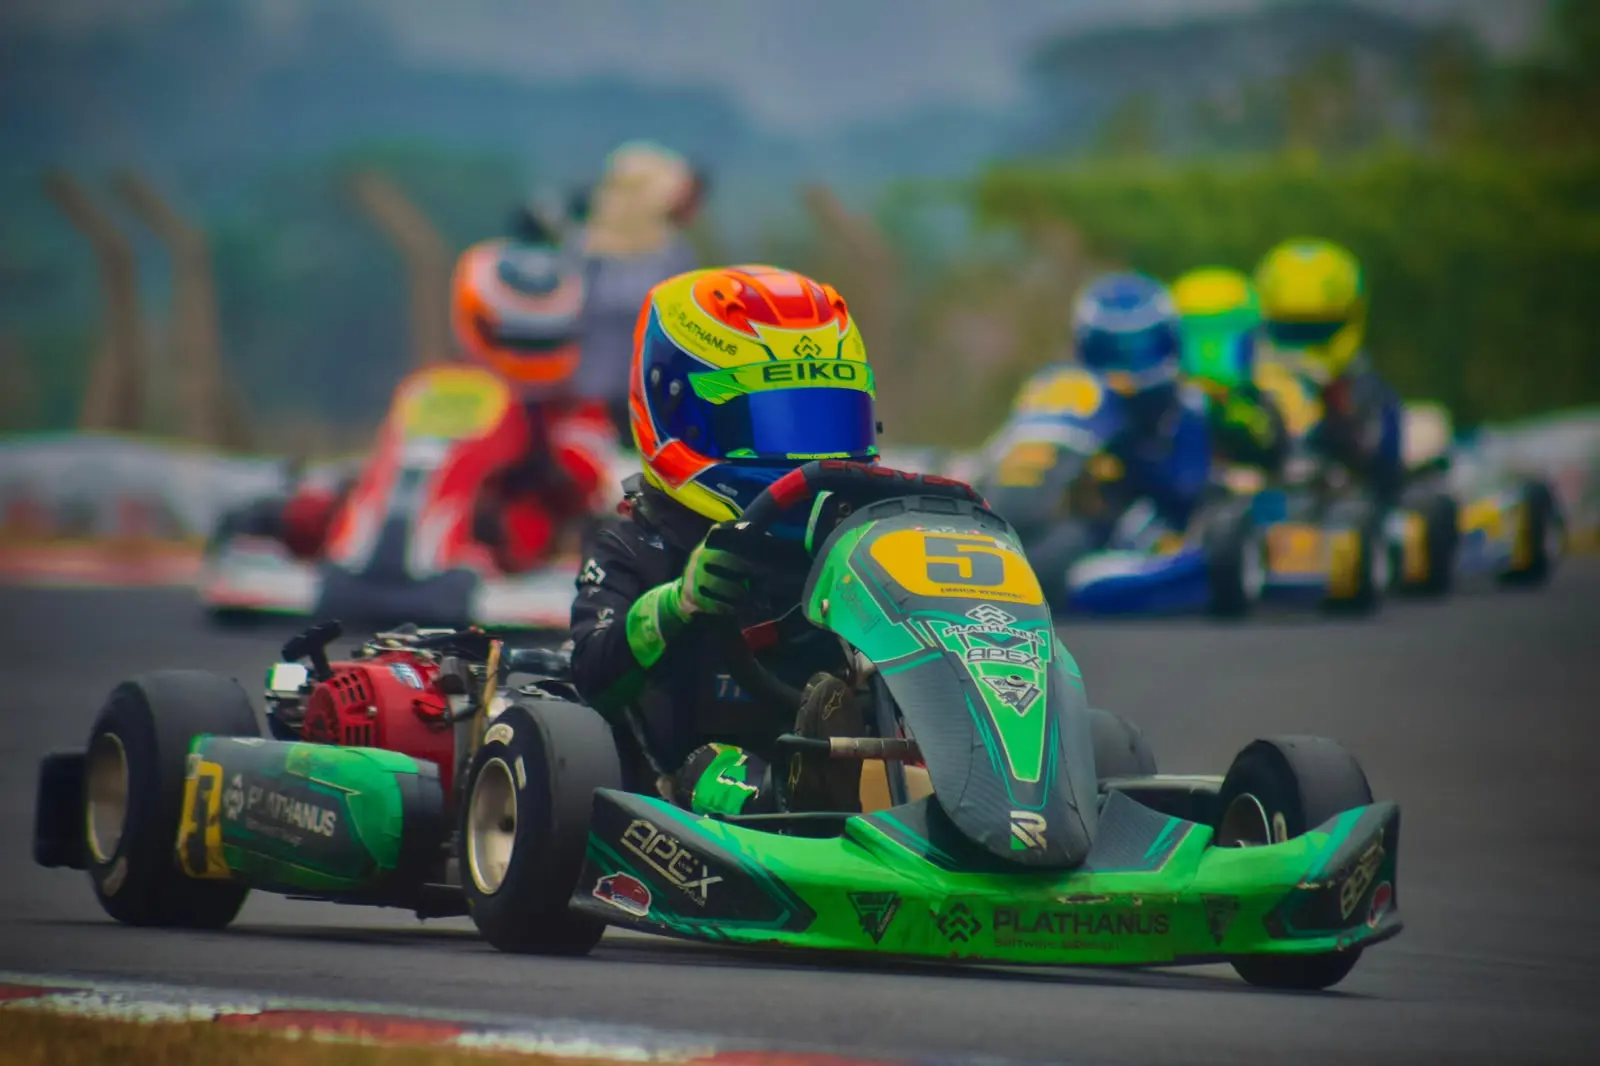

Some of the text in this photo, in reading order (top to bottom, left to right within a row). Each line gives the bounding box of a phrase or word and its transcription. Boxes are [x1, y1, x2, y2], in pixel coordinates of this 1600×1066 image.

[678, 311, 738, 356] PLATHANUS
[763, 363, 856, 383] EIKO
[924, 536, 1004, 587] 5
[943, 624, 1046, 646] PLATHANUS
[968, 648, 1042, 671] APEX
[621, 819, 723, 899] APEX
[994, 905, 1170, 935] PLATHANUS
